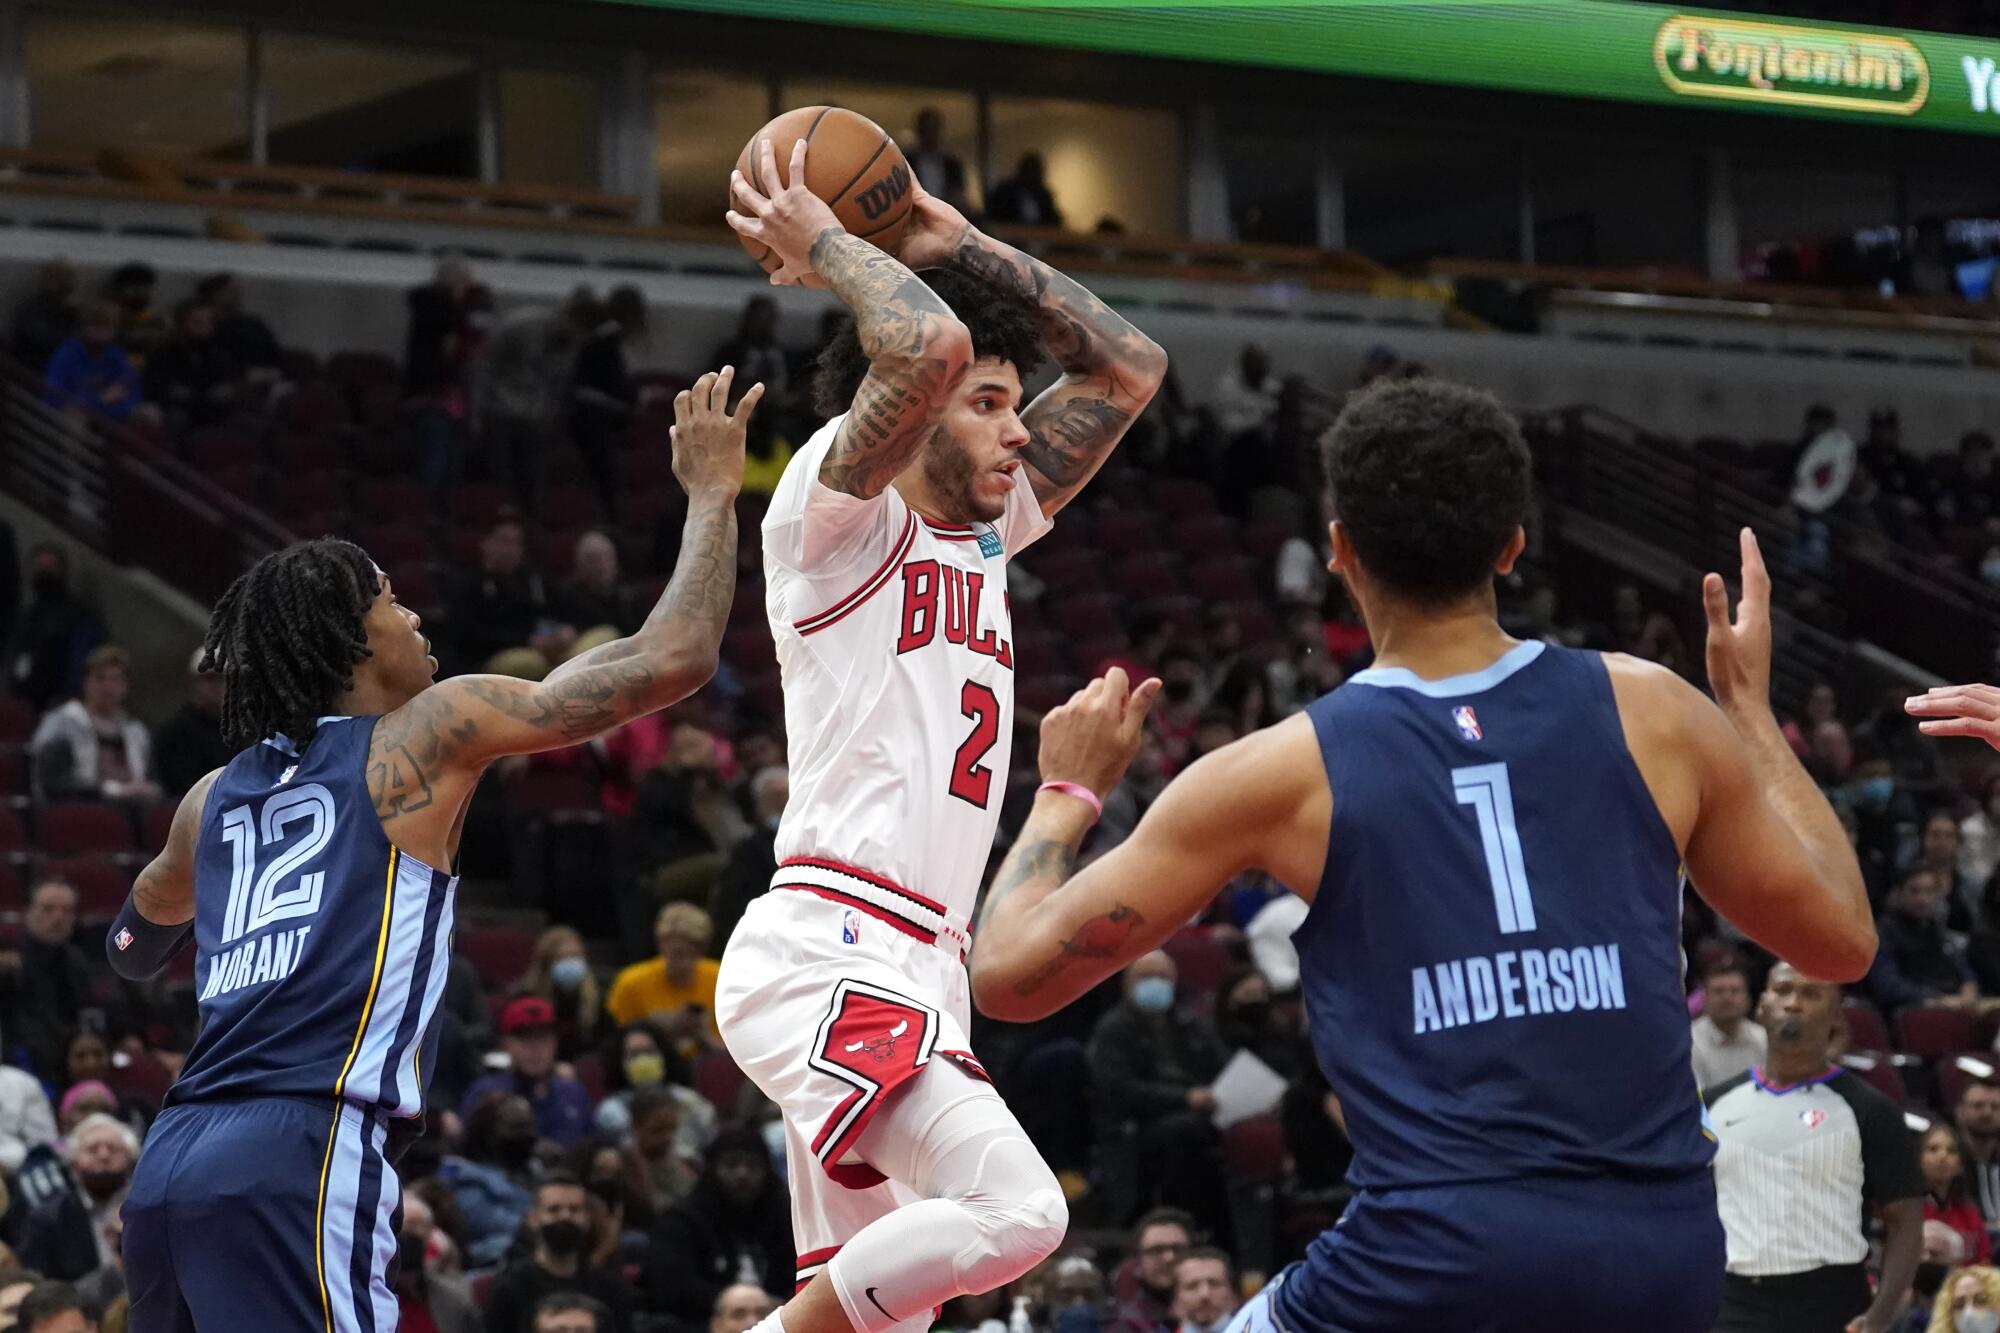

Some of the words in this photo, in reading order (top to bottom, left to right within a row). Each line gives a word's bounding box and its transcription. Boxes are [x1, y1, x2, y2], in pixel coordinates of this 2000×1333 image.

[948, 678, 1000, 810] 2
[222, 783, 336, 944] 12
[1451, 762, 1537, 934] 1
[198, 925, 311, 1002] MORANT
[1411, 943, 1627, 1035] ANDERSON
